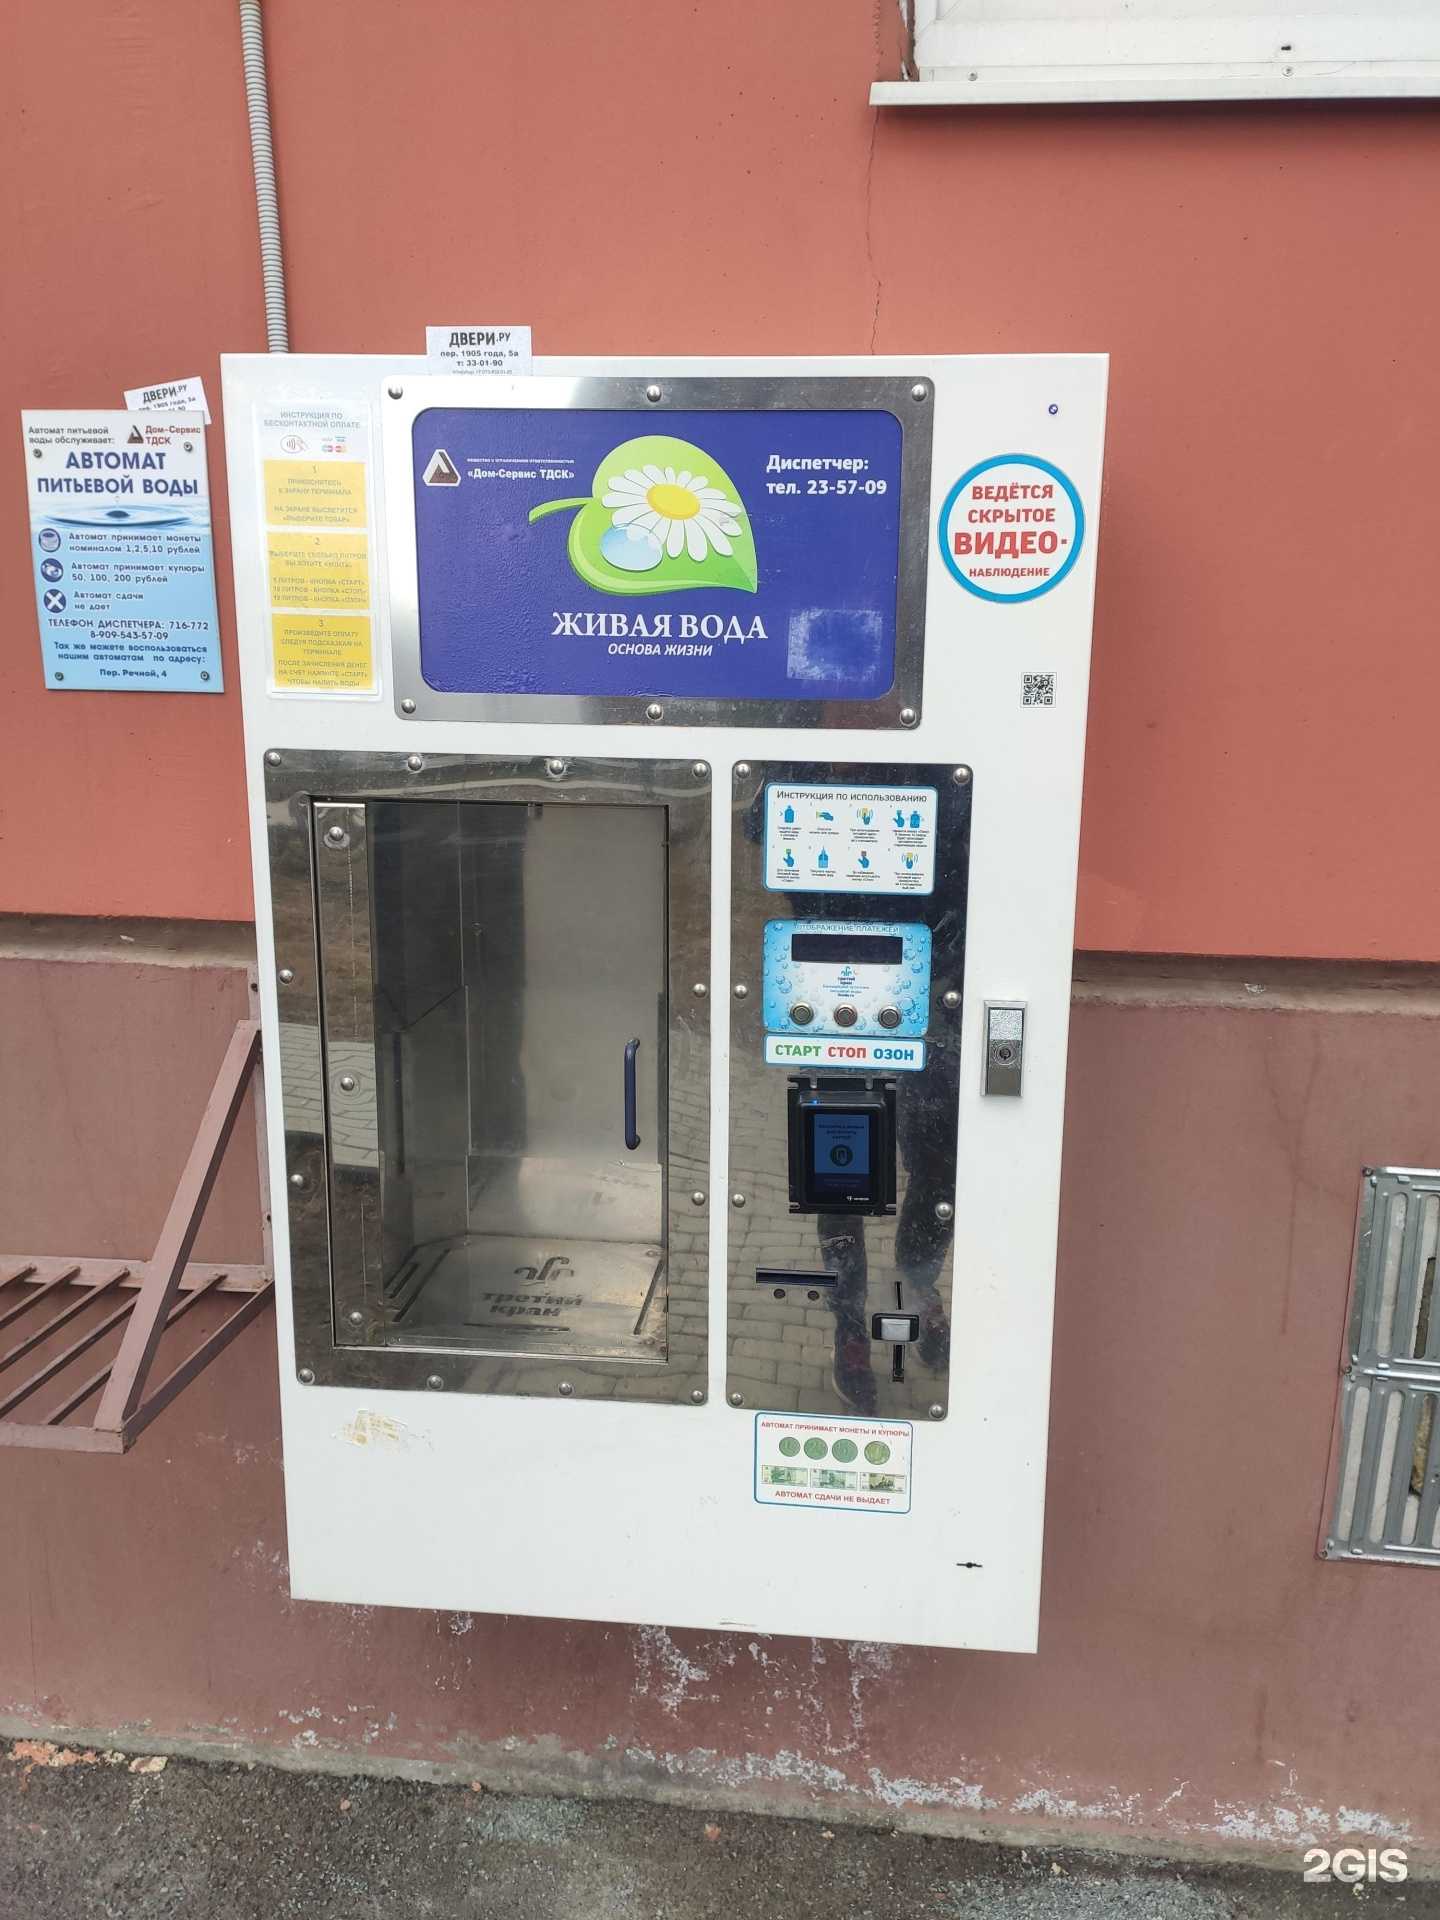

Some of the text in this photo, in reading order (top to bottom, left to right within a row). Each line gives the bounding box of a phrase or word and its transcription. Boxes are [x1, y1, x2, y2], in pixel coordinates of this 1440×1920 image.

[449, 332, 511, 348] ДВЕРИ.РУ
[143, 384, 187, 404] ДВЕРИ.РУ
[280, 411, 329, 419] ИНСТРУКЦИЯ
[28, 426, 109, 435] Автомат питьевой
[145, 425, 201, 434] Дом-Сервис
[29, 437, 115, 445] воды обслуживает:
[146, 436, 171, 445] ТДСК
[65, 452, 166, 469] АВТОМАТ
[766, 454, 869, 475] Диспетчер:
[468, 468, 574, 481] «Дом-Сервис ТДСК»
[38, 475, 198, 497] ПИТЬЕВОЙ ВОДЫ
[766, 480, 887, 495] тел. 23-57-09
[972, 482, 1054, 502] ВЕДЁТСЯ
[968, 508, 1056, 523] СКРЫТОЕ
[69, 533, 107, 541] Автомат
[112, 534, 162, 543] принимает
[167, 545, 200, 555] рублей
[72, 563, 205, 573] Автомат принимает купюры
[969, 567, 1050, 578] НАБЛЮДЕНИЕ
[114, 574, 131, 582] 200
[135, 574, 168, 584] рублей
[74, 591, 143, 601] Автомат сдачи
[48, 619, 209, 630] ТЕЛЕФОН ДИСПЕТЧЕРА: 716-772
[551, 611, 769, 645] ЖИВАЯ ВОДА
[90, 631, 168, 640] 8-909-543-57-09
[54, 642, 69, 650] Так
[128, 645, 207, 653] воспользоваться
[608, 643, 713, 657] ОСНОВА ЖИЗНИ
[169, 656, 205, 665] адресу:
[100, 669, 120, 677] Пер.
[122, 669, 160, 678] Речной,
[775, 1044, 914, 1061] СТАРТ СТОП ОЗОН
[761, 1421, 793, 1429] АВТОМАТ
[795, 1424, 838, 1433] ПРИНИМАЕТ
[839, 1427, 870, 1435] МОНЕТЫ
[878, 1429, 910, 1437] КУПЮРЫ
[775, 1490, 812, 1499] АВТОМАТ
[814, 1493, 842, 1502] СДАЧИ
[857, 1496, 891, 1505] ВЫДАЕТ
